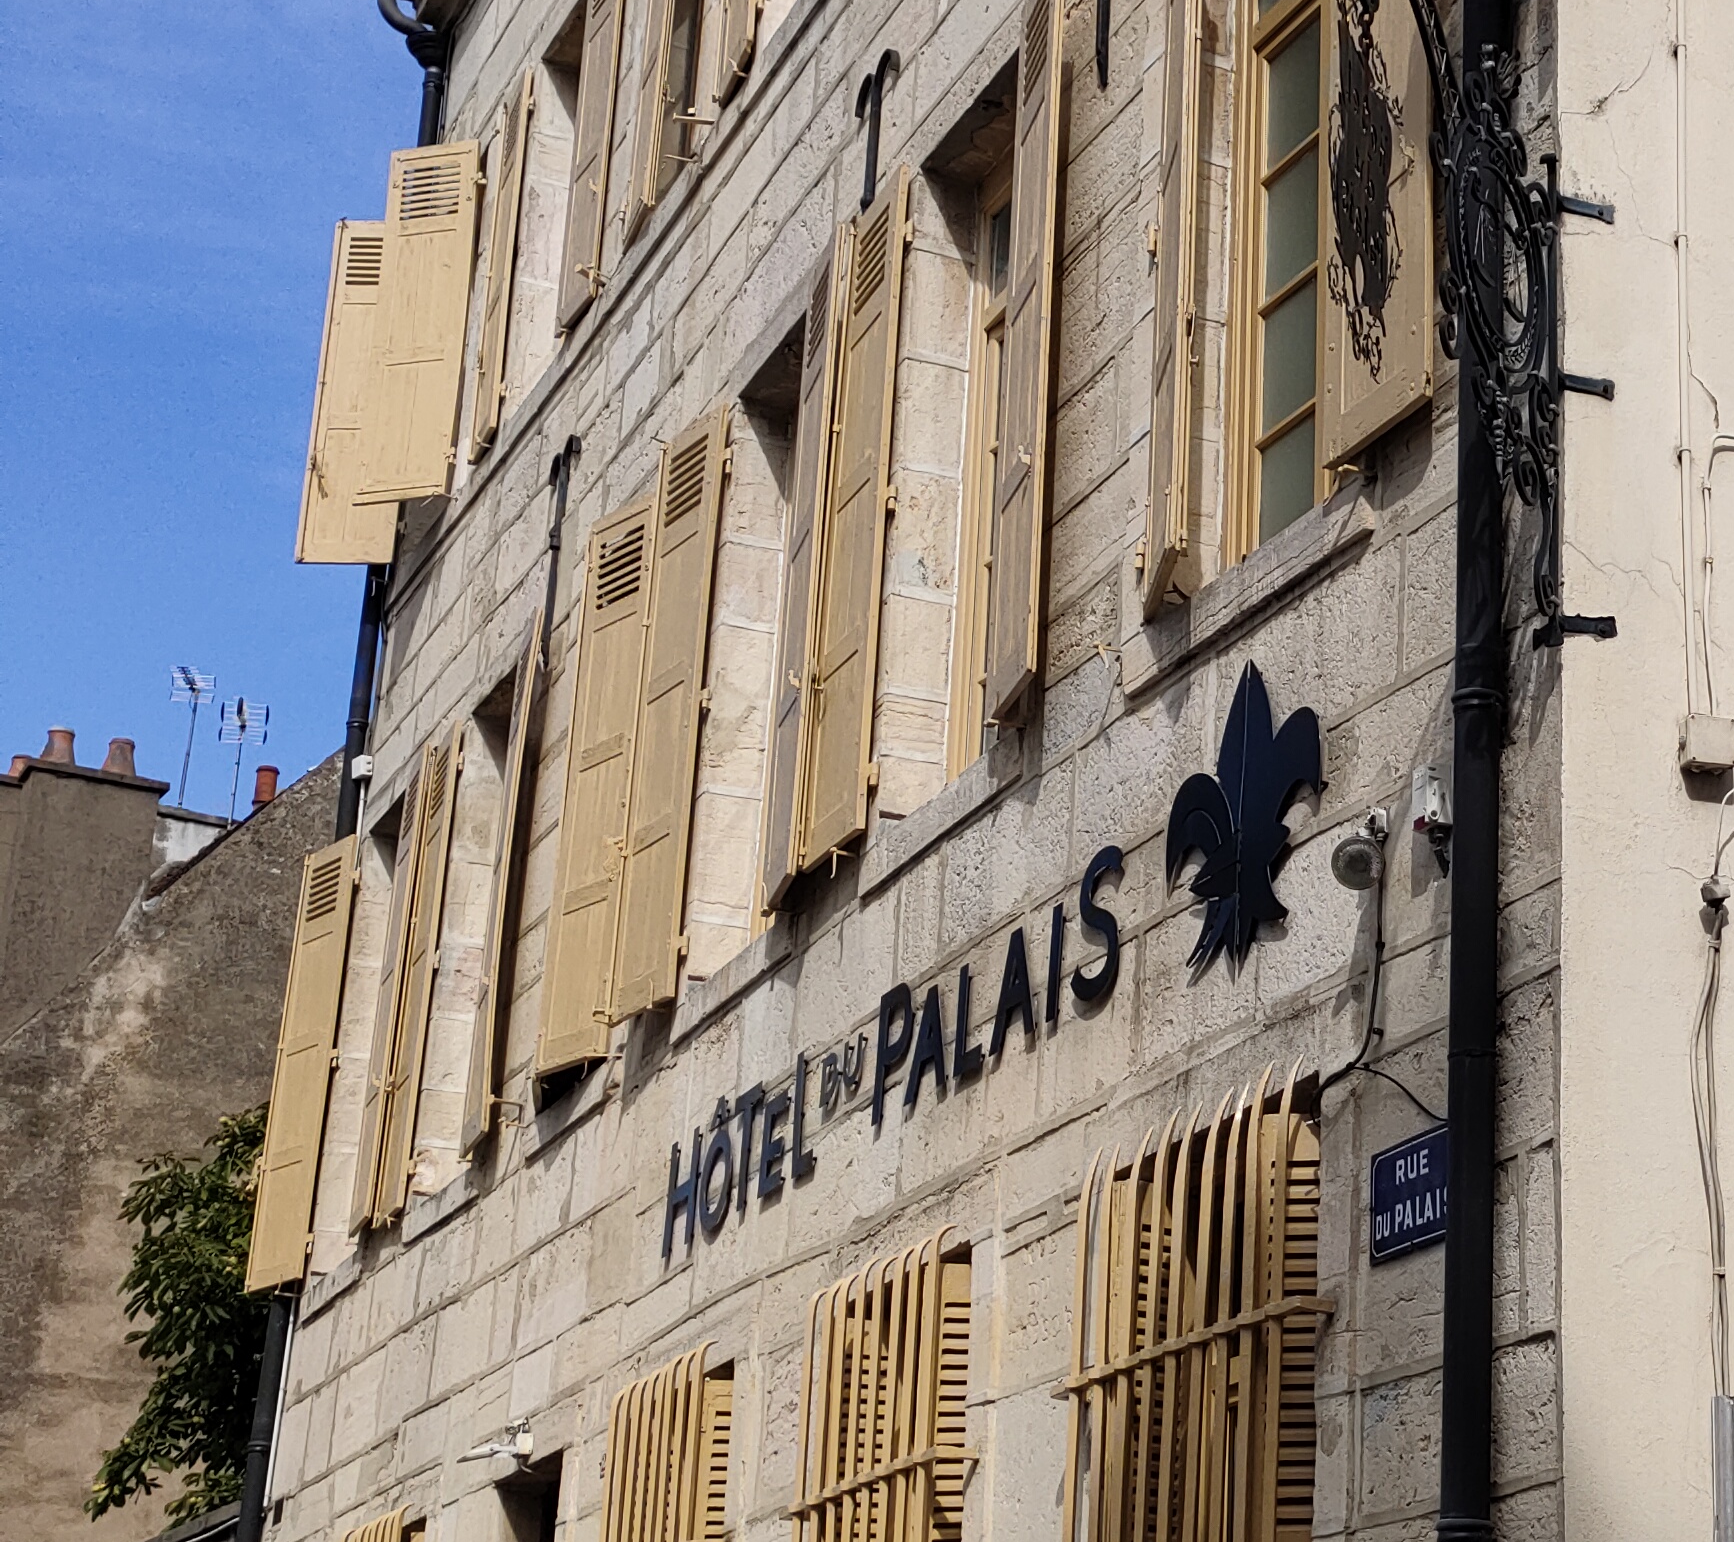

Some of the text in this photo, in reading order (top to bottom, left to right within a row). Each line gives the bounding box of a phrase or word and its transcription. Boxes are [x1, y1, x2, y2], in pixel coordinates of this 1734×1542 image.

[662, 845, 1123, 1259] HÔTEL DU PALAIS
[1395, 1148, 1430, 1186] RUE
[1375, 1211, 1391, 1241] DU
